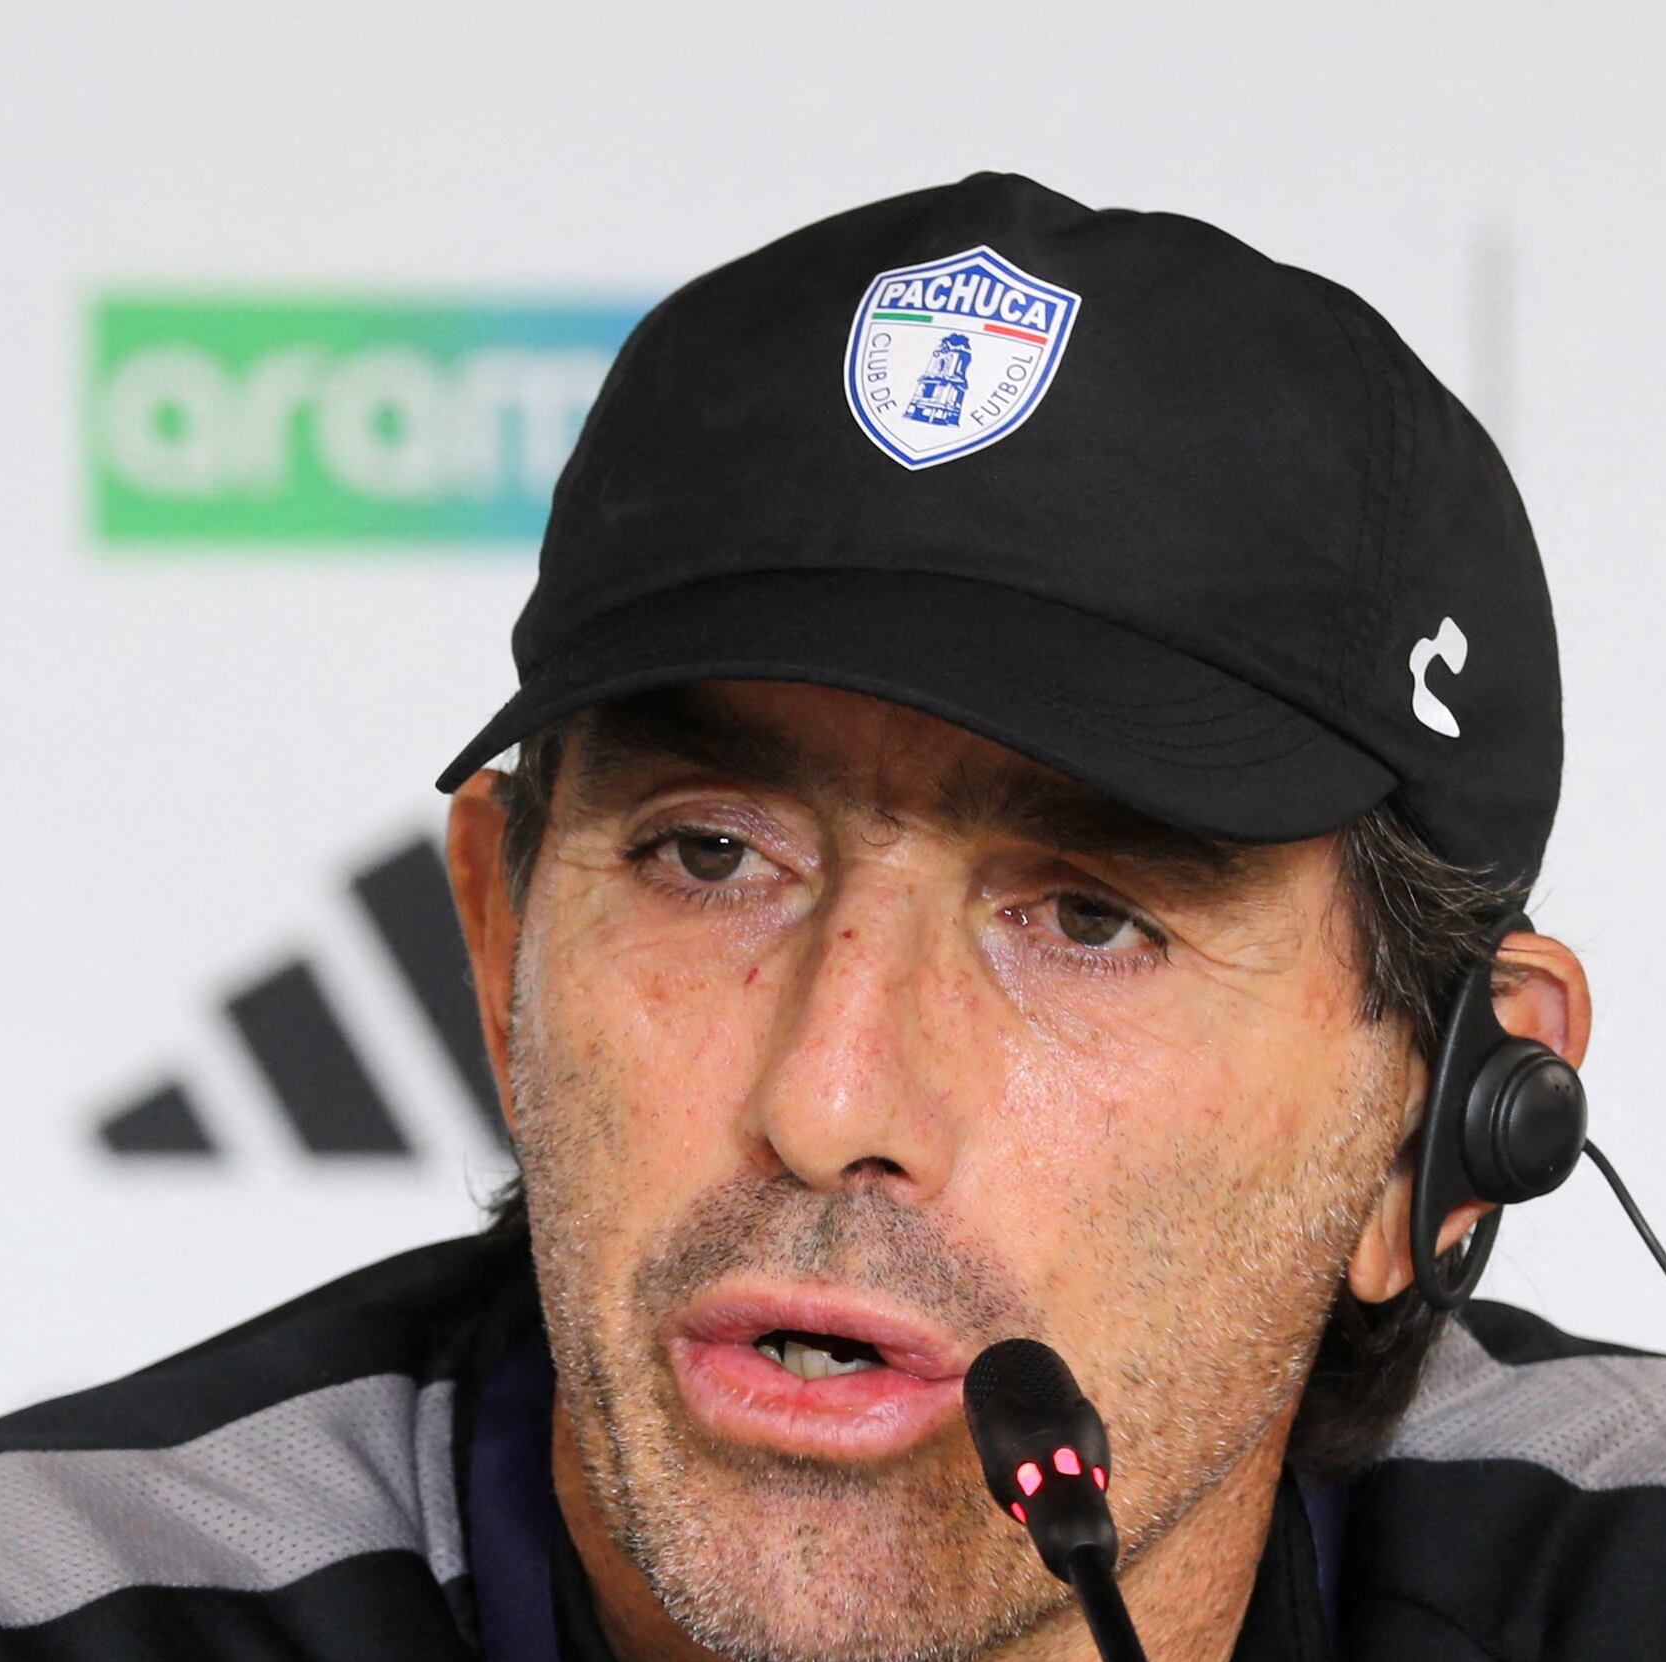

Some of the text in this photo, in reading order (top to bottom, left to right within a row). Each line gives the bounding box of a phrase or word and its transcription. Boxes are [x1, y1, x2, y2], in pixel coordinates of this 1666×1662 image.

[880, 273, 1048, 331] PACHUCA
[867, 332, 898, 415] CLUB DE
[970, 354, 1033, 427] FUTBOL
